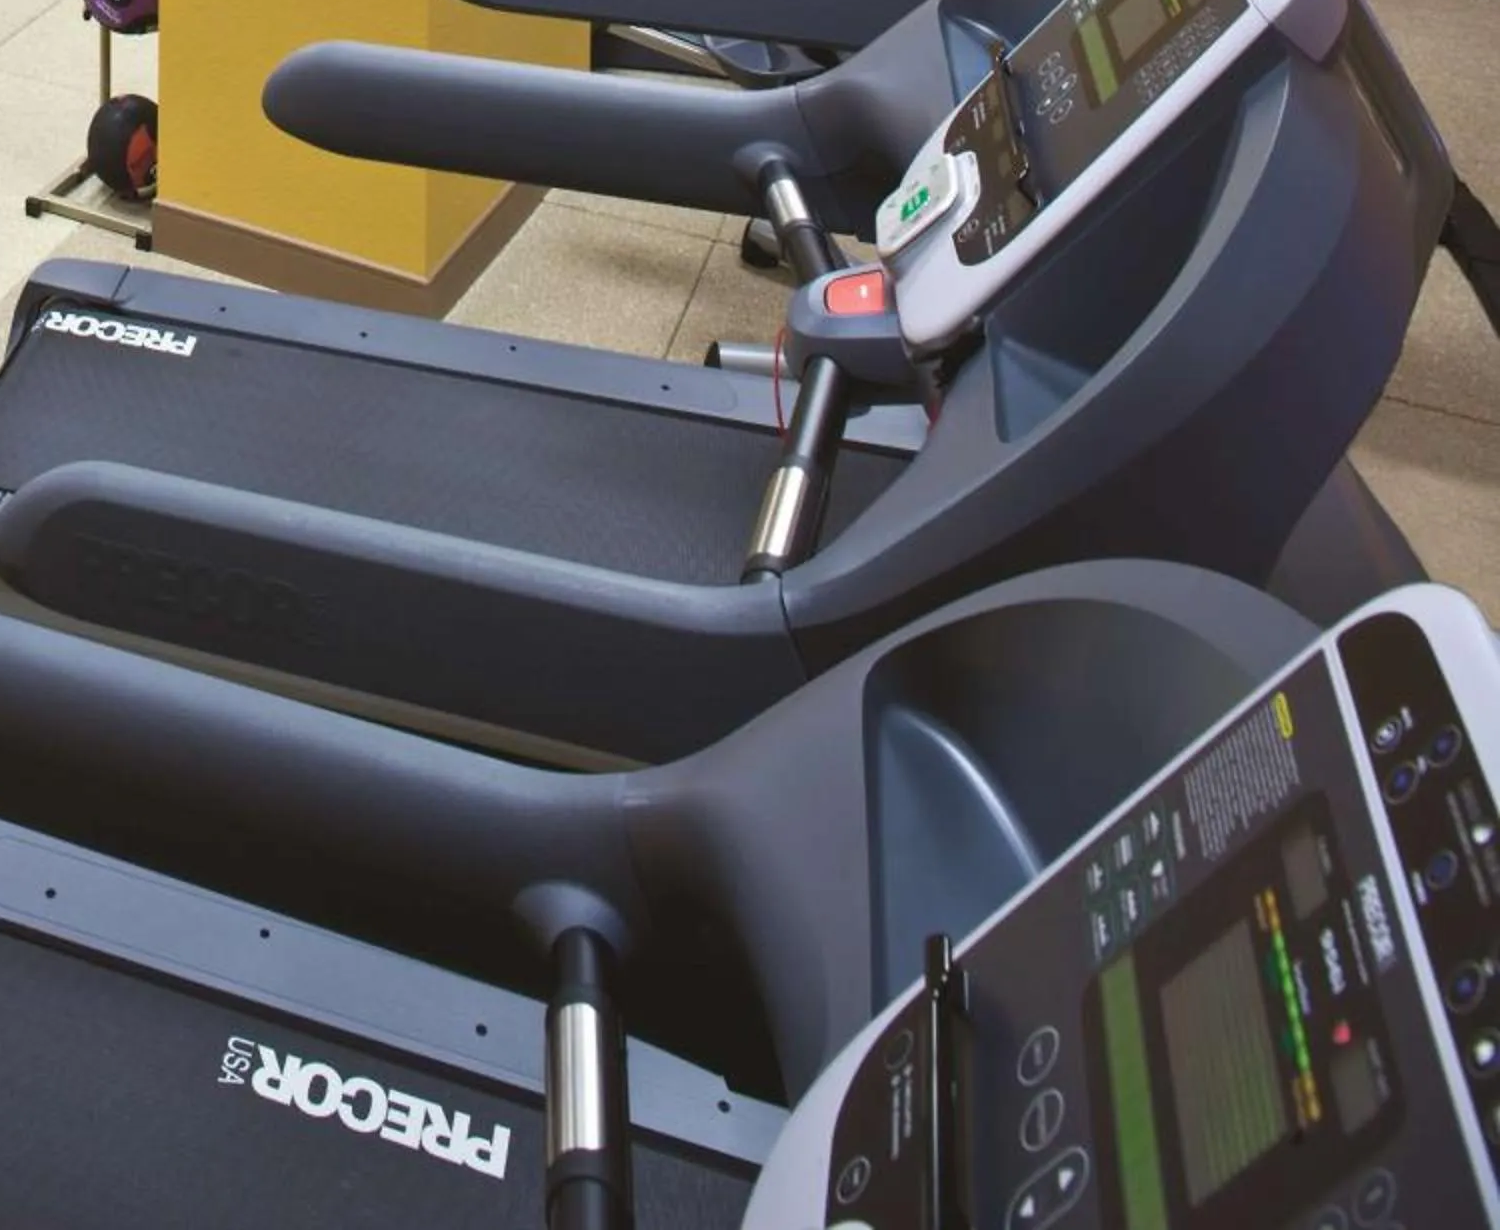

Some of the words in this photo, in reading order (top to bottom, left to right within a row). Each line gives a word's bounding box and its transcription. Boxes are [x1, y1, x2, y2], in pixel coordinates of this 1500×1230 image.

[44, 311, 198, 357] PRECOR
[216, 1035, 255, 1086] USA
[251, 1043, 511, 1180] PRECOR
